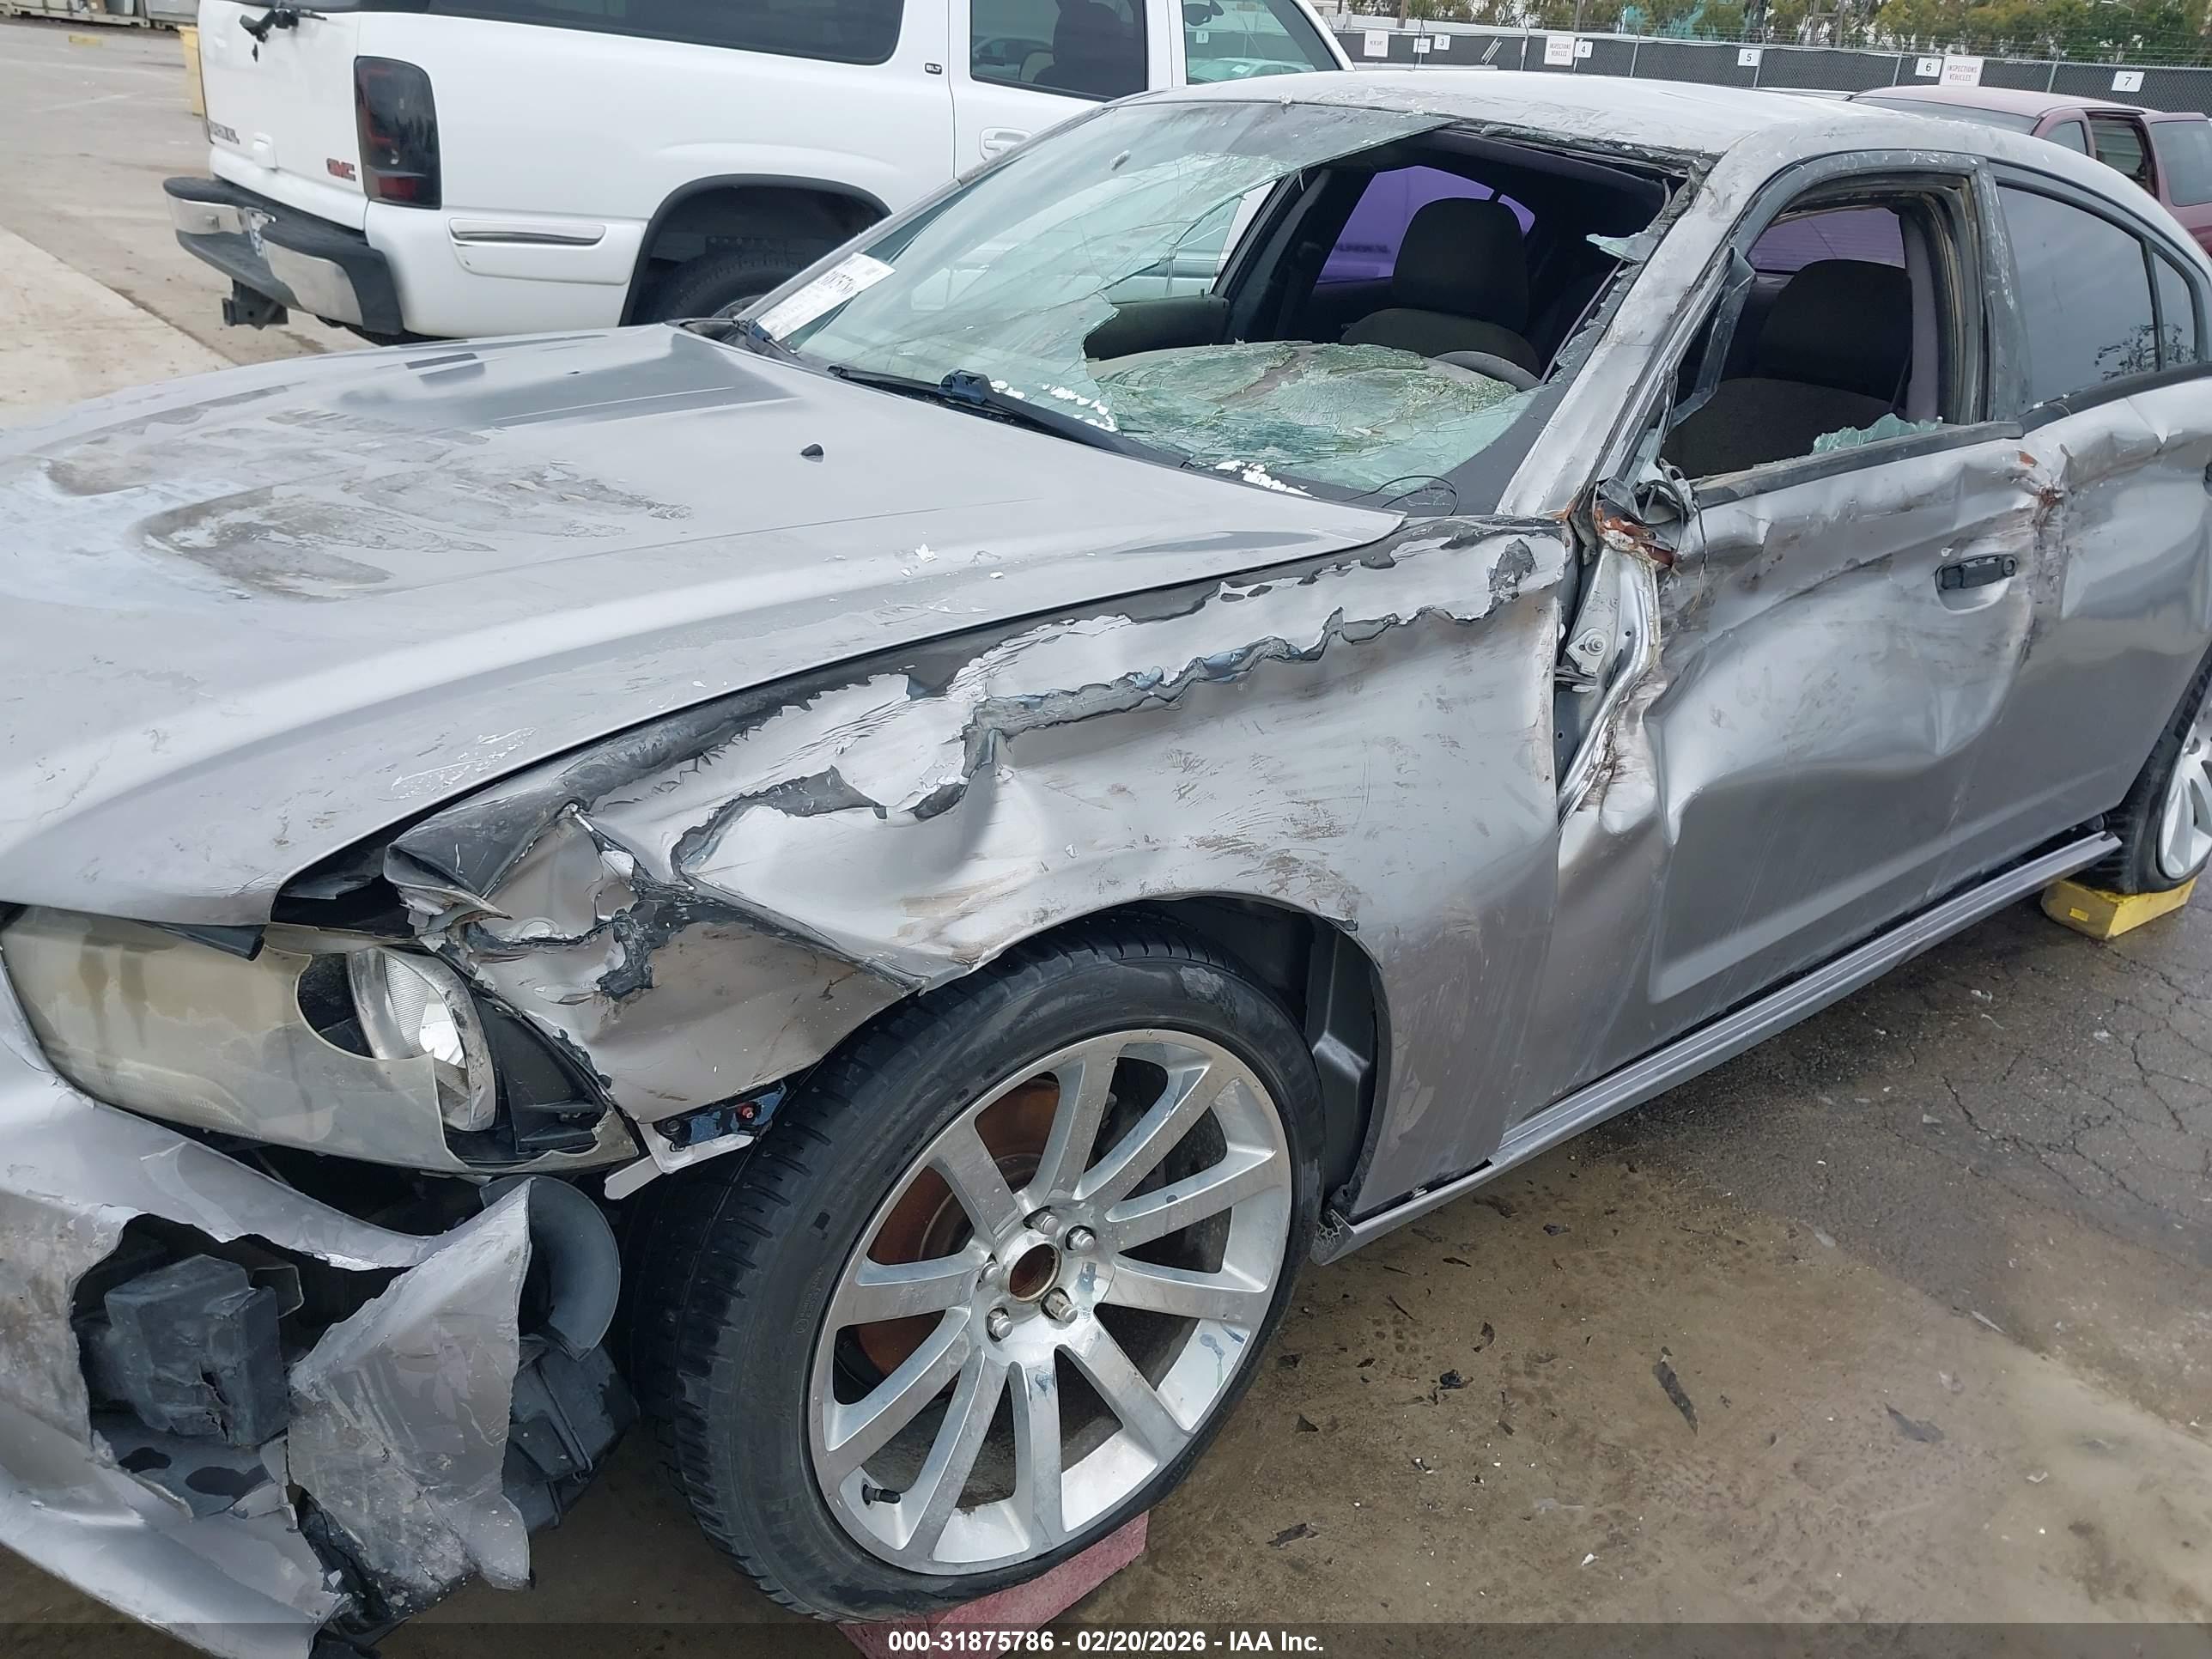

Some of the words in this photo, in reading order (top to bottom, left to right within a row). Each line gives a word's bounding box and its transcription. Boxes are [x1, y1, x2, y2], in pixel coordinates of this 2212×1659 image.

[1581, 45, 1586, 53] 4
[1747, 52, 1753, 62] 5
[1925, 62, 1932, 72] 6
[1947, 64, 1978, 73] INSPECTIONS
[1949, 73, 1972, 82] VEHICLES
[2125, 76, 2132, 86] 7
[325, 157, 356, 181] GMC
